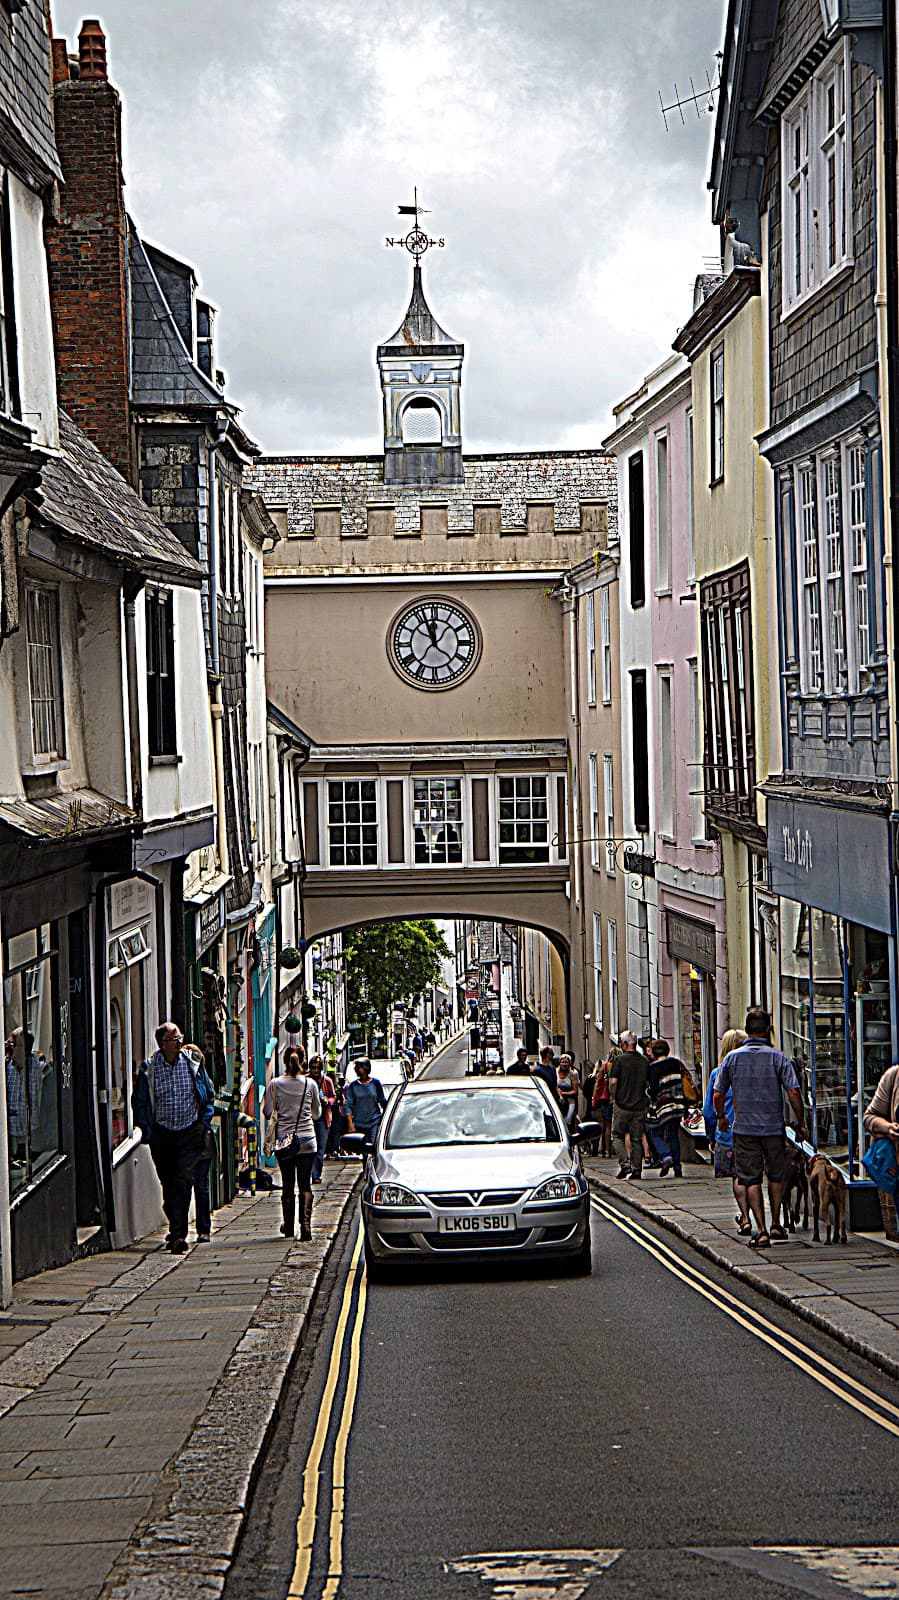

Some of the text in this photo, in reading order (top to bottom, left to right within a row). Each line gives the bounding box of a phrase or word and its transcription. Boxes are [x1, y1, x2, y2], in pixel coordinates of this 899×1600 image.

[385, 238, 395, 247] N
[438, 238, 445, 247] S
[797, 828, 813, 873] Loft
[445, 1215, 509, 1231] LK06 SBU
